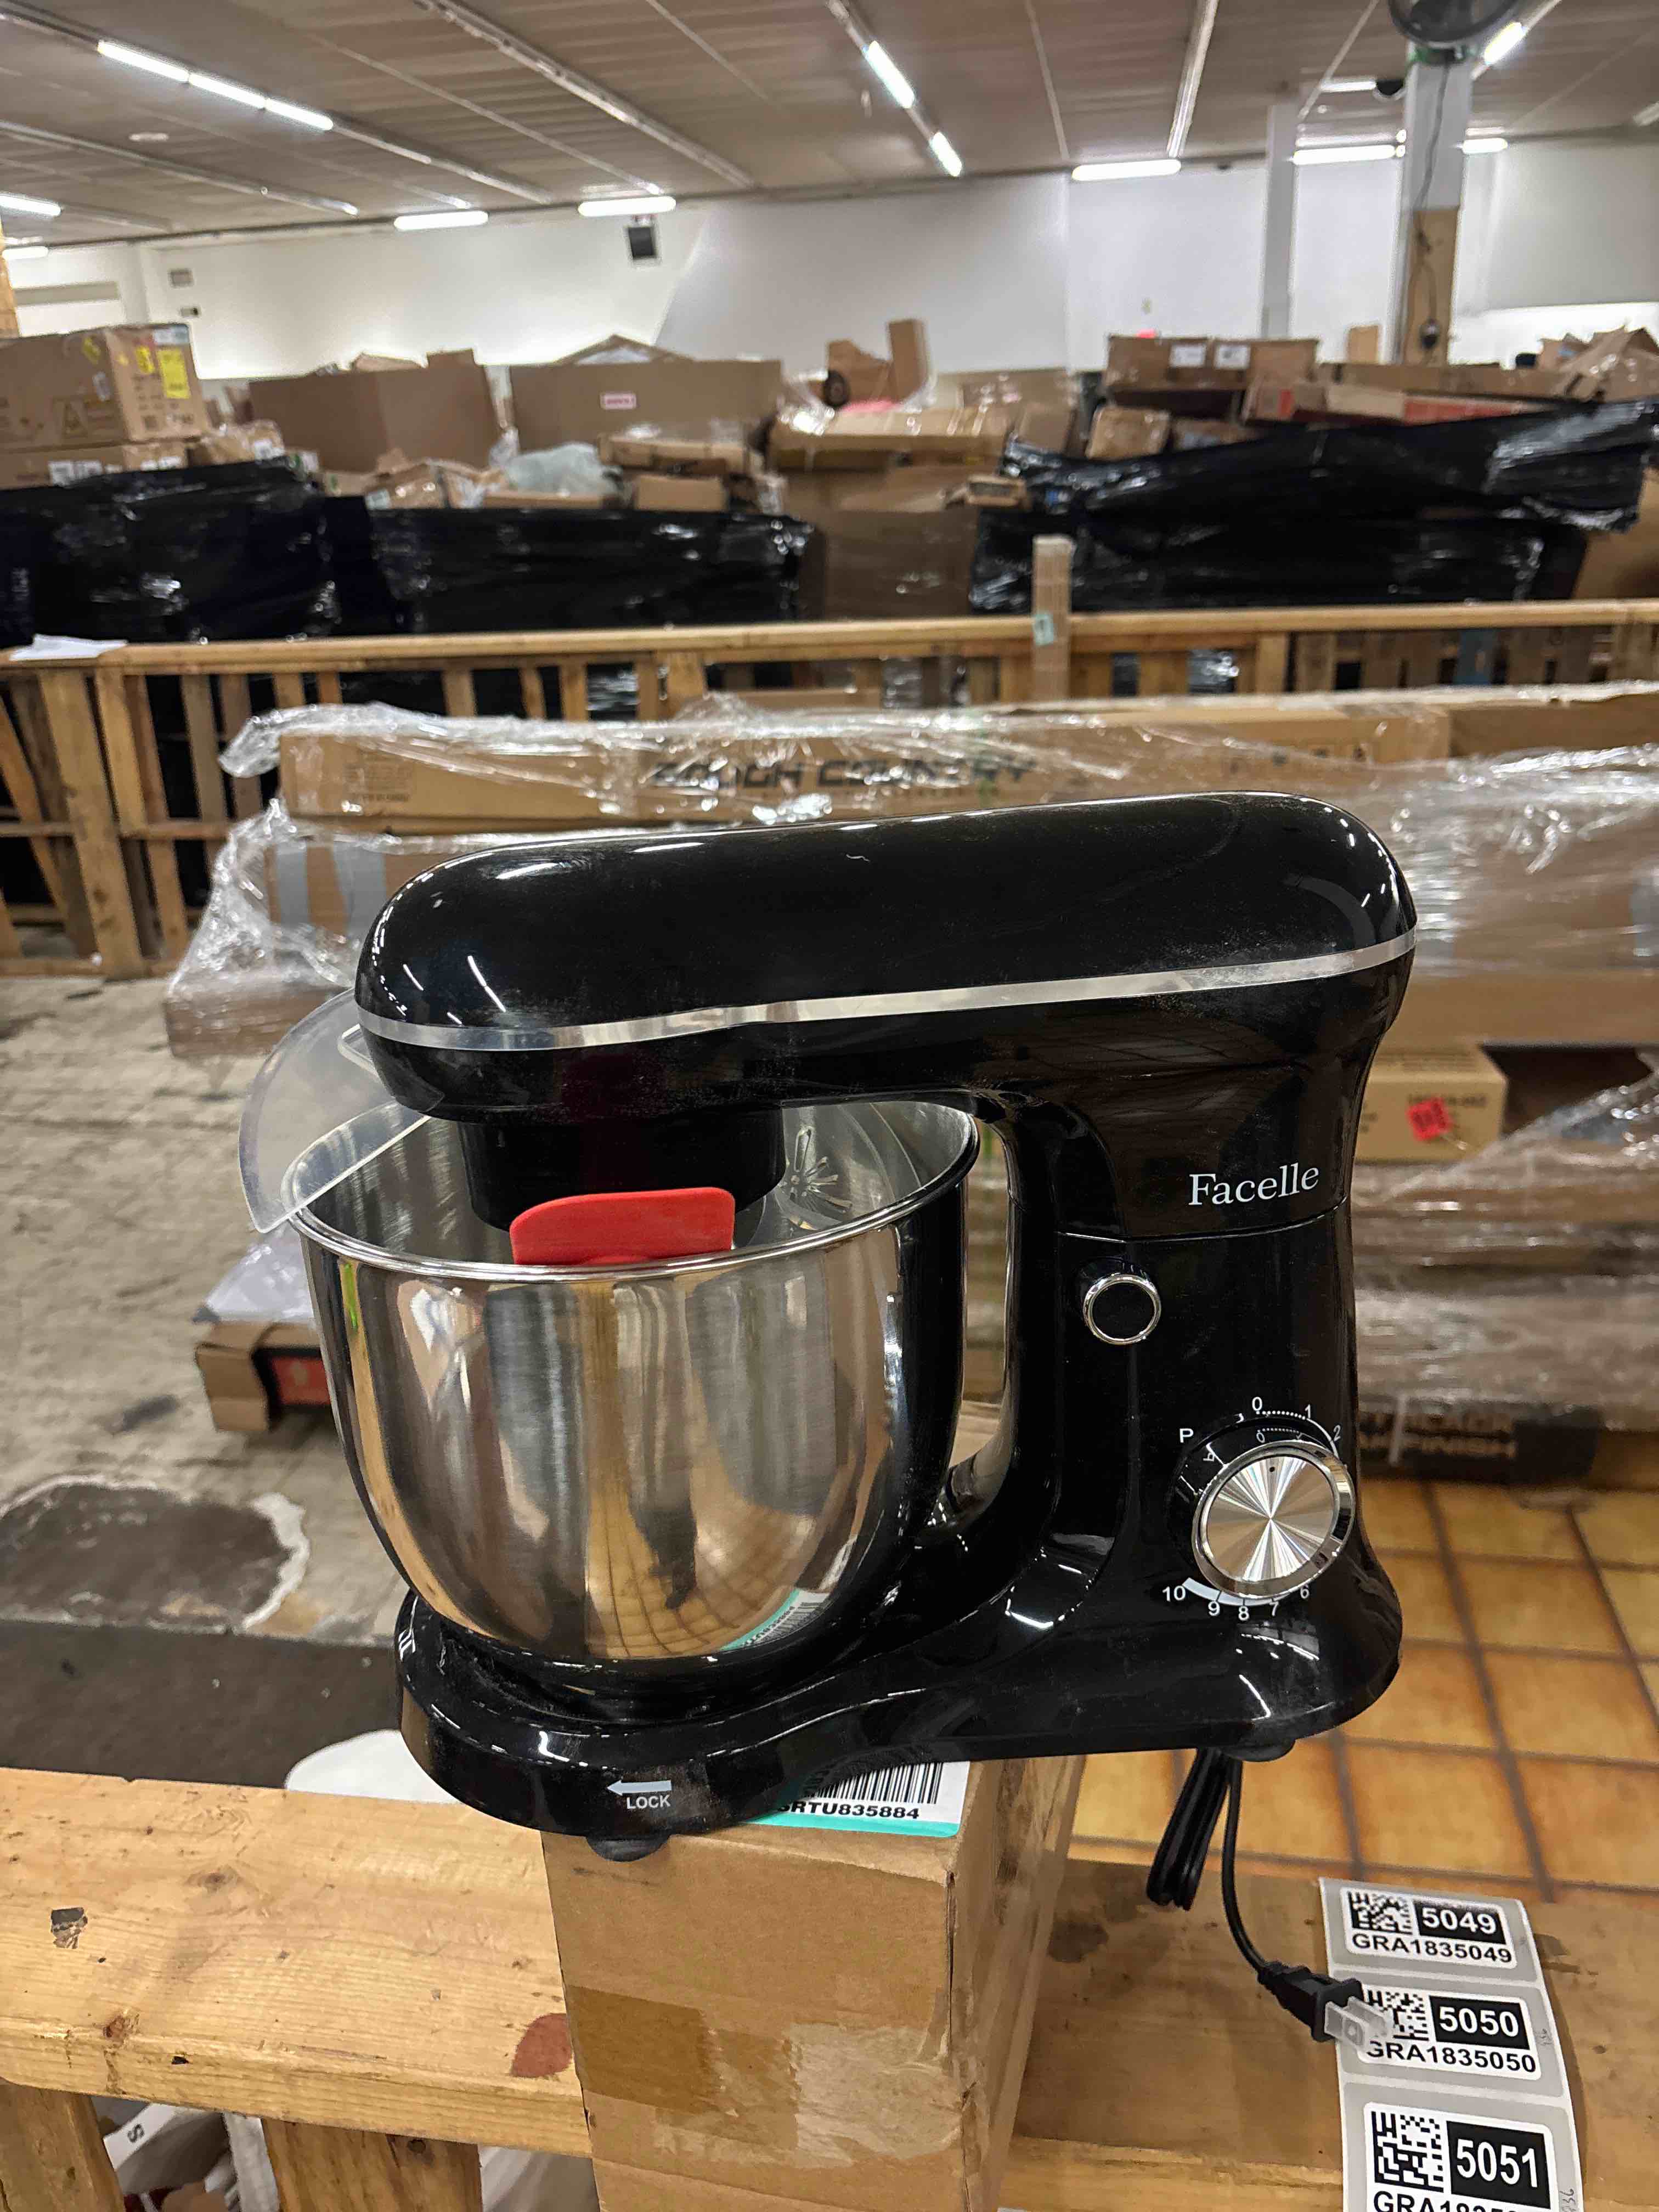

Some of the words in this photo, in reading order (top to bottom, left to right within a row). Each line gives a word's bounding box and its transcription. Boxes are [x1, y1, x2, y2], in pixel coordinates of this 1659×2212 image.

[1188, 1163, 1319, 1205] Facelle
[1252, 1396, 1263, 1412] 0
[1305, 1404, 1311, 1418] 1
[1179, 1428, 1194, 1443] P
[1333, 1424, 1341, 1442] 2
[1162, 1585, 1186, 1602] 10
[1300, 1583, 1310, 1599] 6
[1207, 1600, 1221, 1617] 9
[1238, 1605, 1250, 1621] 8
[1268, 1601, 1279, 1616] 7
[626, 1795, 671, 1809] LOCK
[1421, 1907, 1497, 1934] 5049
[1352, 1933, 1513, 1963] GRA1835049
[1438, 2006, 1519, 2037] 5050
[1366, 2040, 1537, 2073] GRA1835050
[1457, 2138, 1538, 2188] 5051
